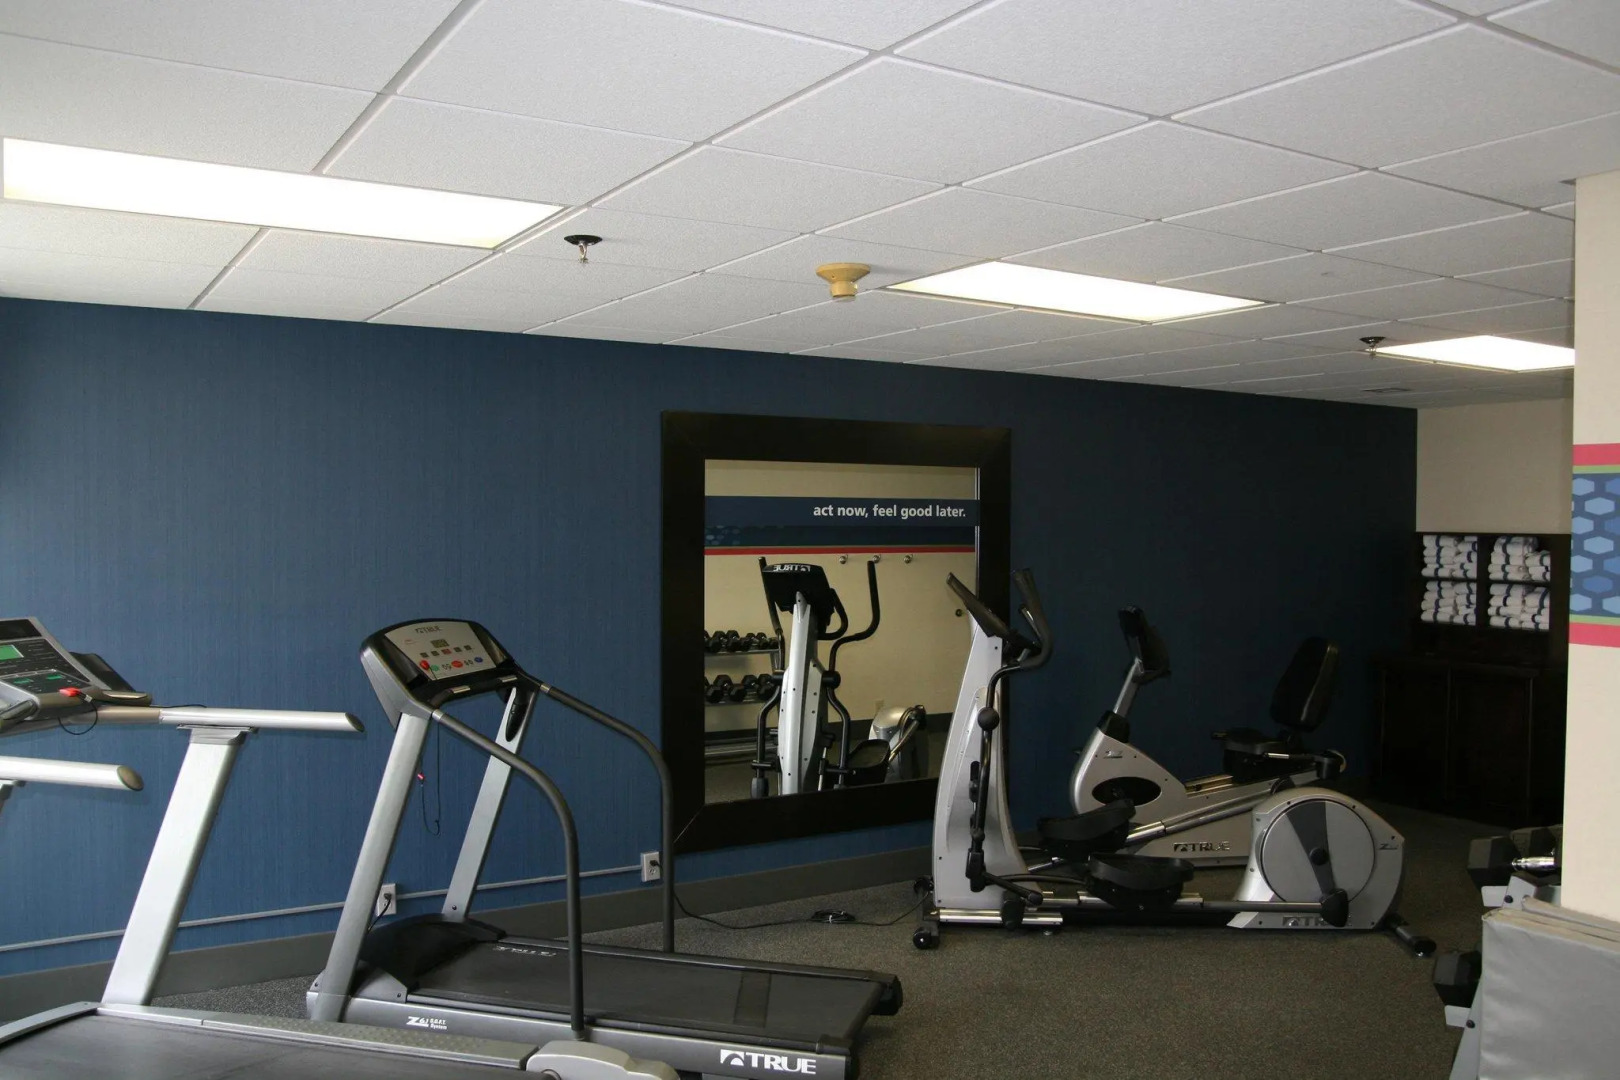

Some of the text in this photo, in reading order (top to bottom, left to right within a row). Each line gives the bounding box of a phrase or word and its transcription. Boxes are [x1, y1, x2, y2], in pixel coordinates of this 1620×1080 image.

[813, 504, 966, 519] act now, feel good later.
[1188, 840, 1230, 852] TRUE
[745, 1052, 817, 1075] TRUE
